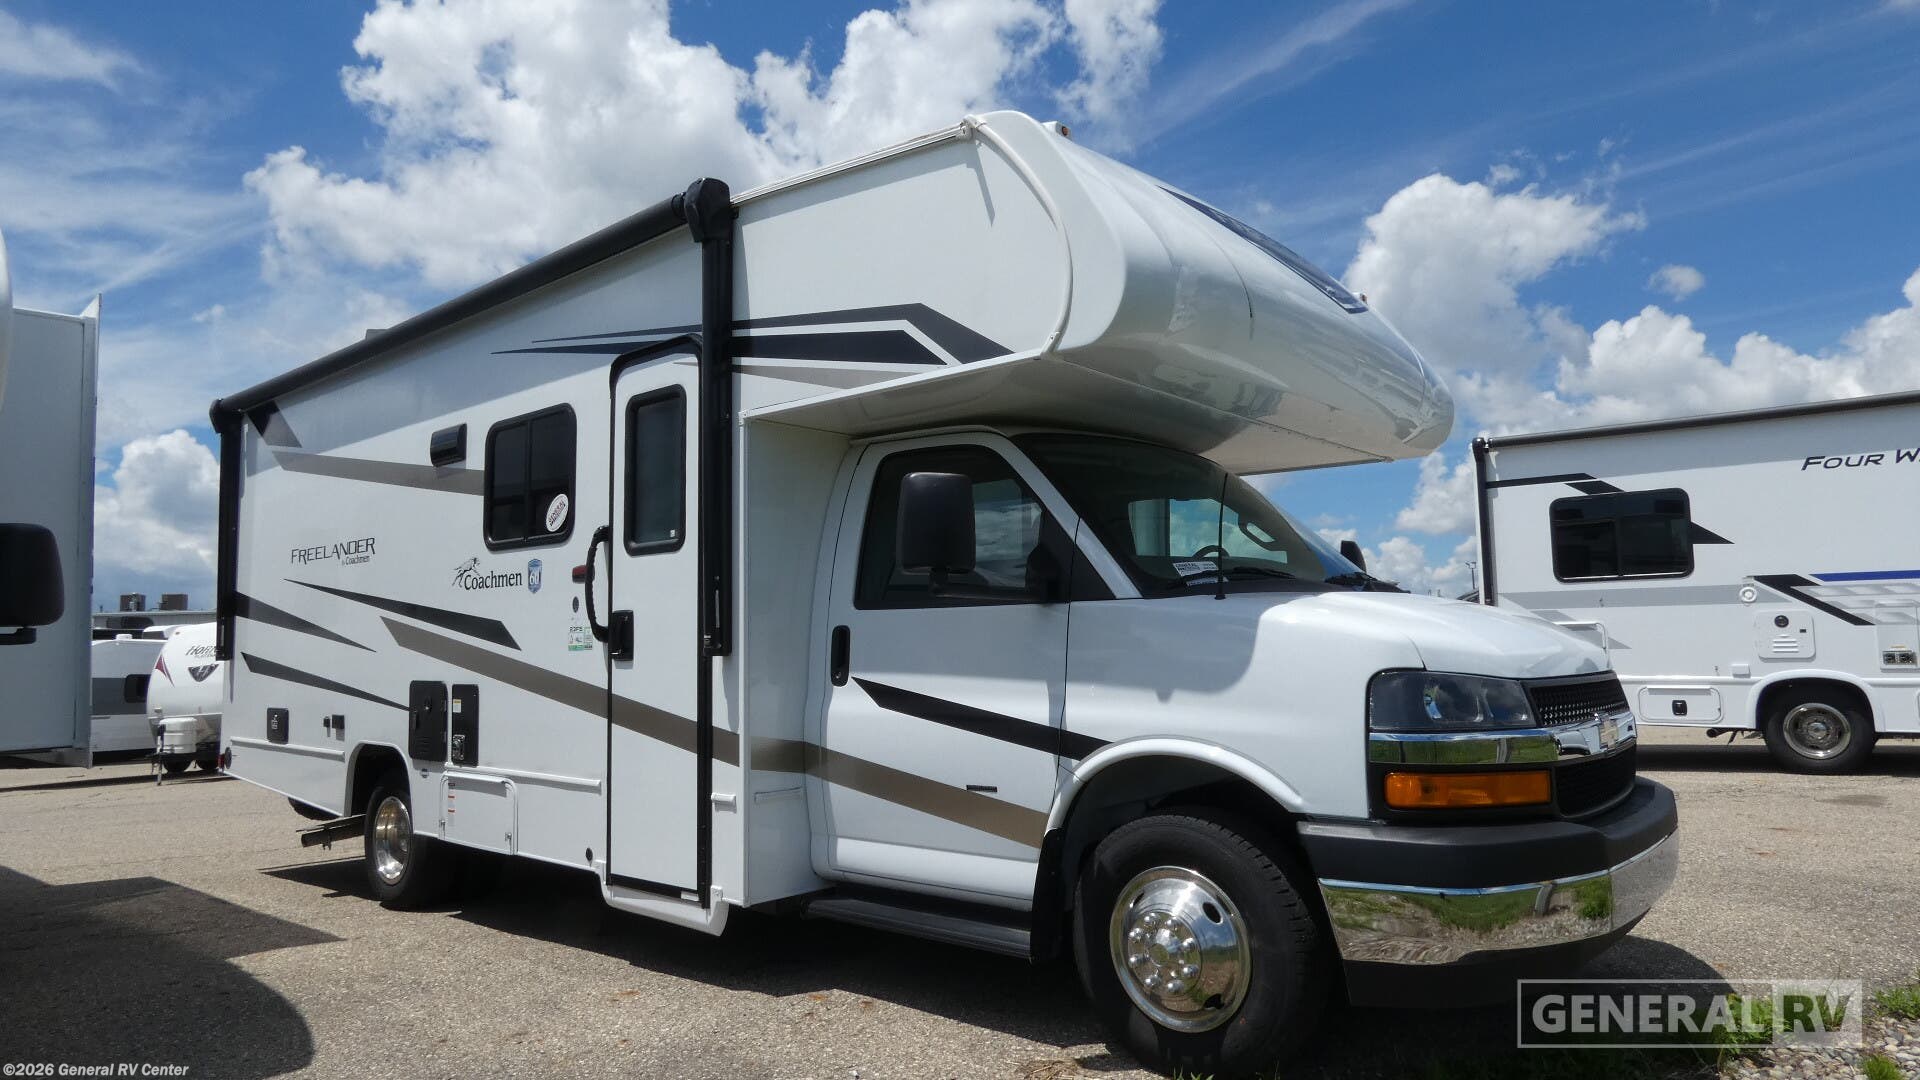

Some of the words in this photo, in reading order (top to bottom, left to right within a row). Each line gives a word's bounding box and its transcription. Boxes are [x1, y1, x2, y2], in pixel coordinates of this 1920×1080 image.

[1801, 453, 1885, 471] FOUR
[1895, 447, 1920, 464] W
[291, 537, 376, 565] FREELANDER
[464, 570, 523, 590] Coachmen
[185, 645, 217, 656] HORN
